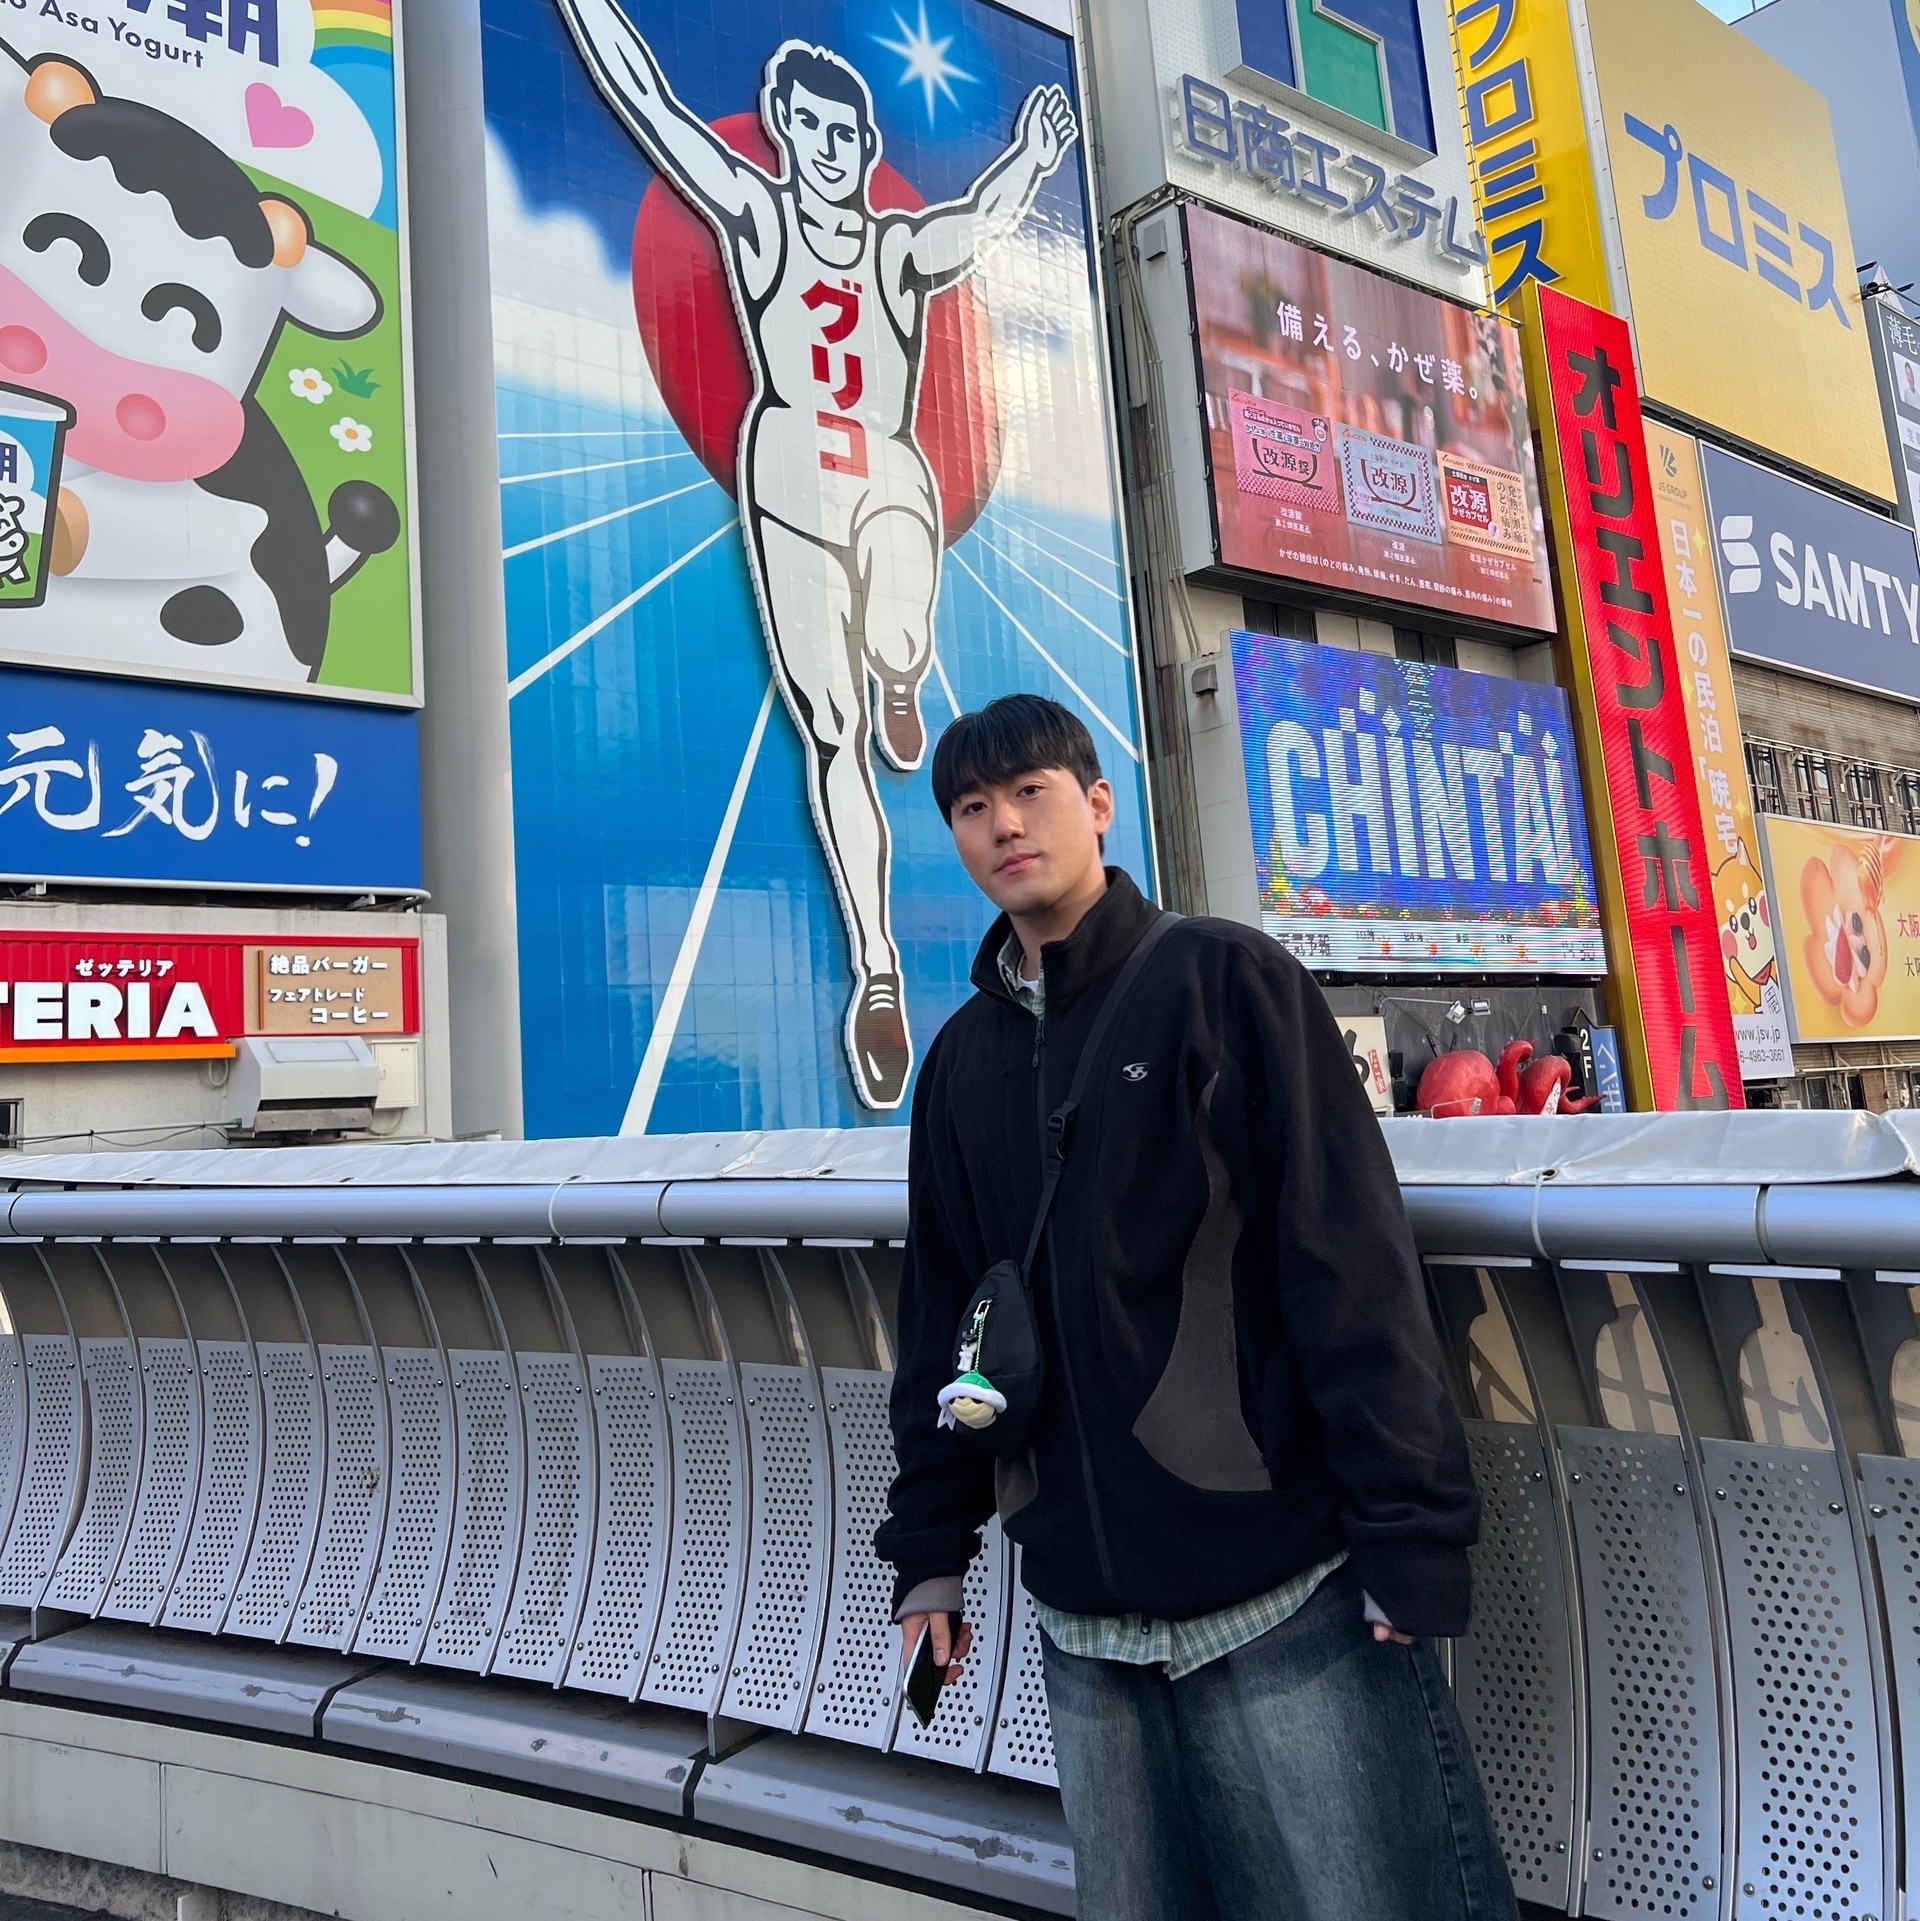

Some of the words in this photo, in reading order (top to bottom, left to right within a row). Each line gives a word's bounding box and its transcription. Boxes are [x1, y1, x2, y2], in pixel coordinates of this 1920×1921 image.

[39, 0, 99, 34] Asa
[107, 17, 203, 68] Yogurt
[1178, 73, 1488, 274] 日商エステム
[1624, 112, 1852, 331] プロミス
[800, 278, 869, 479] グリコ
[1277, 301, 1478, 400] 備える、かぜ薬。
[1449, 484, 1489, 514] 改源
[1770, 531, 1919, 645] SAMTY
[1566, 346, 1729, 1111] オリエントホーム
[1268, 689, 1575, 885] CHINTAI
[75, 957, 174, 978] ゼッテリア
[269, 954, 388, 975] 絶品バーガー
[269, 987, 366, 1003] フェアトレード
[0, 981, 219, 1040] ERIA
[311, 1005, 390, 1024] コーヒー
